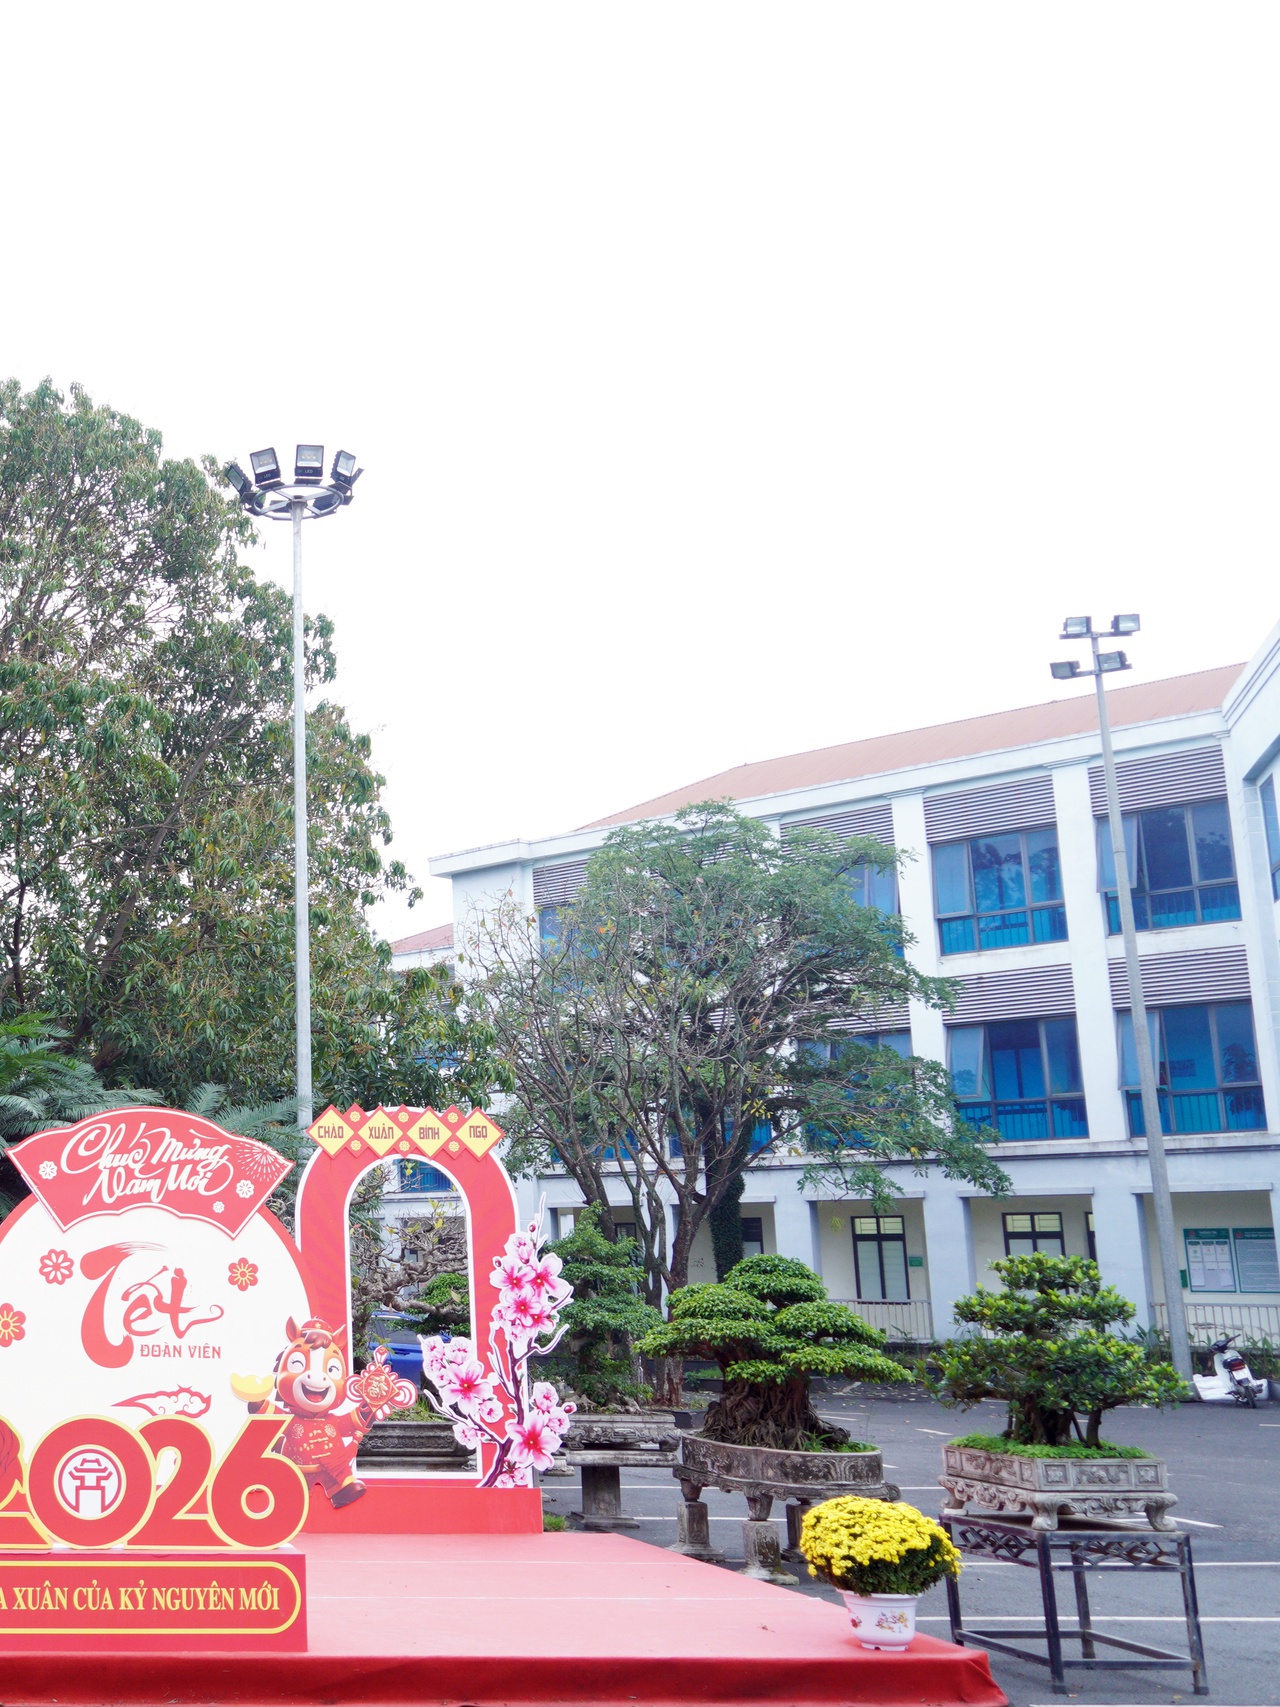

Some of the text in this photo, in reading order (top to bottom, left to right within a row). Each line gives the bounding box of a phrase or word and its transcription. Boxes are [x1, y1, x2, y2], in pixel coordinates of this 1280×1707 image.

[317, 1123, 488, 1141] CHÀO XUÂN BÍNH NGỌ
[60, 1122, 233, 1174] Chúc Mừng
[79, 1241, 224, 1369] Tết
[140, 1341, 221, 1359] ĐOÀN VIÊN
[13, 1580, 69, 1610] XUÂN
[73, 1579, 115, 1610] CỦA
[119, 1580, 148, 1610] KỶ
[152, 1581, 235, 1610] NGUYÊN
[239, 1580, 280, 1610] MỚI
